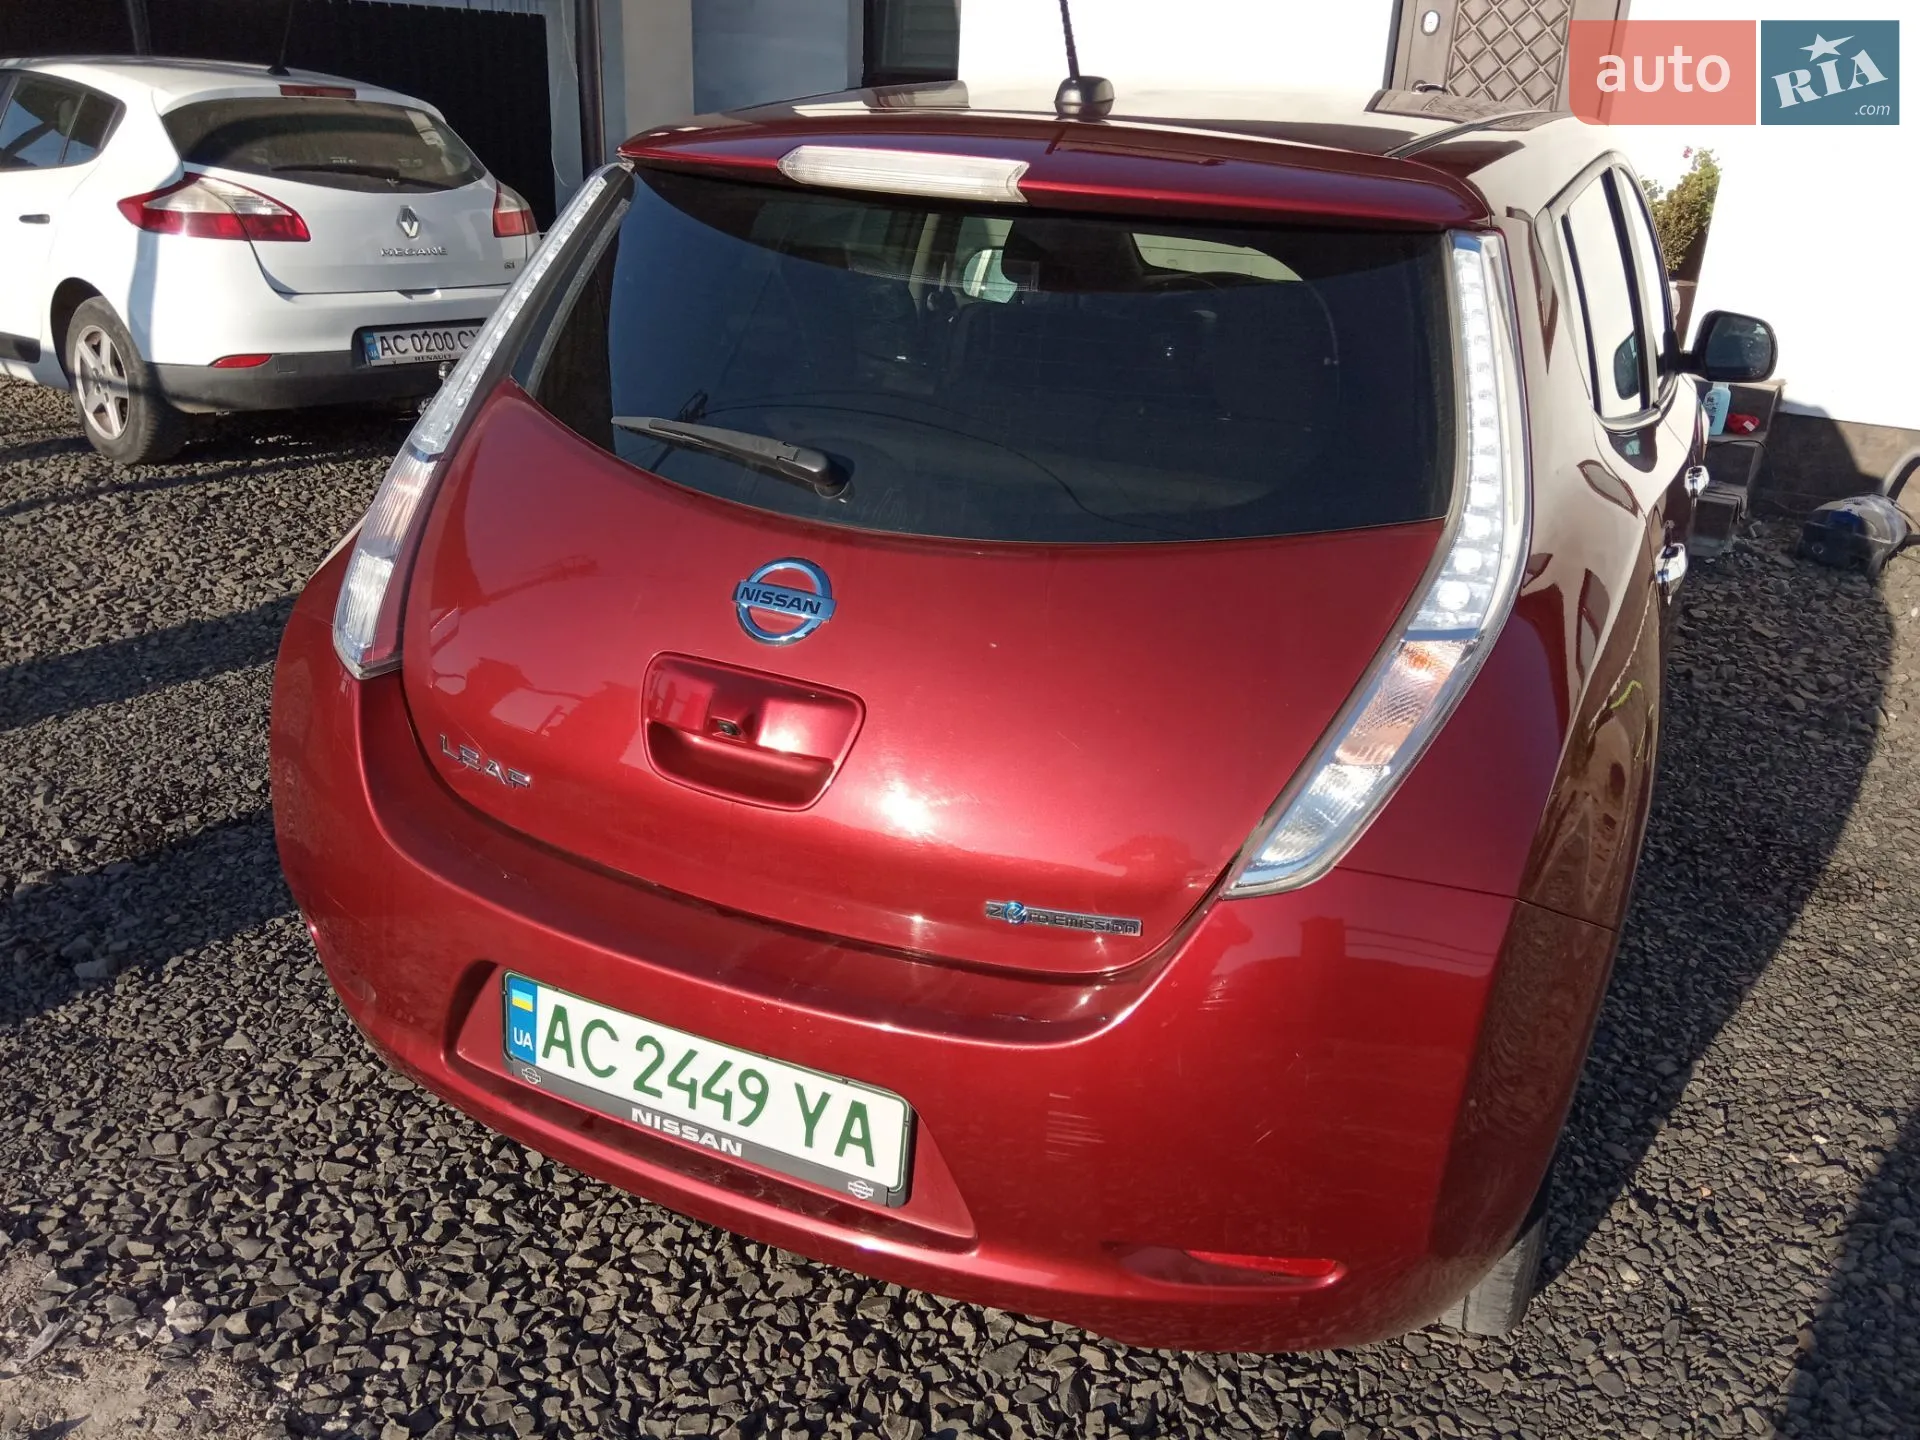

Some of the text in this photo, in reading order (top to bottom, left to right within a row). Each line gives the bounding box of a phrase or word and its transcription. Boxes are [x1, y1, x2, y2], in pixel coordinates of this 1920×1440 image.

[380, 334, 408, 356] AC
[410, 330, 455, 353] 0200
[414, 353, 452, 362] RENAULT
[740, 586, 821, 615] NISSAN
[513, 1027, 534, 1051] UA
[541, 1004, 875, 1168] AC 2449 YA
[631, 1108, 743, 1158] NISSAN
